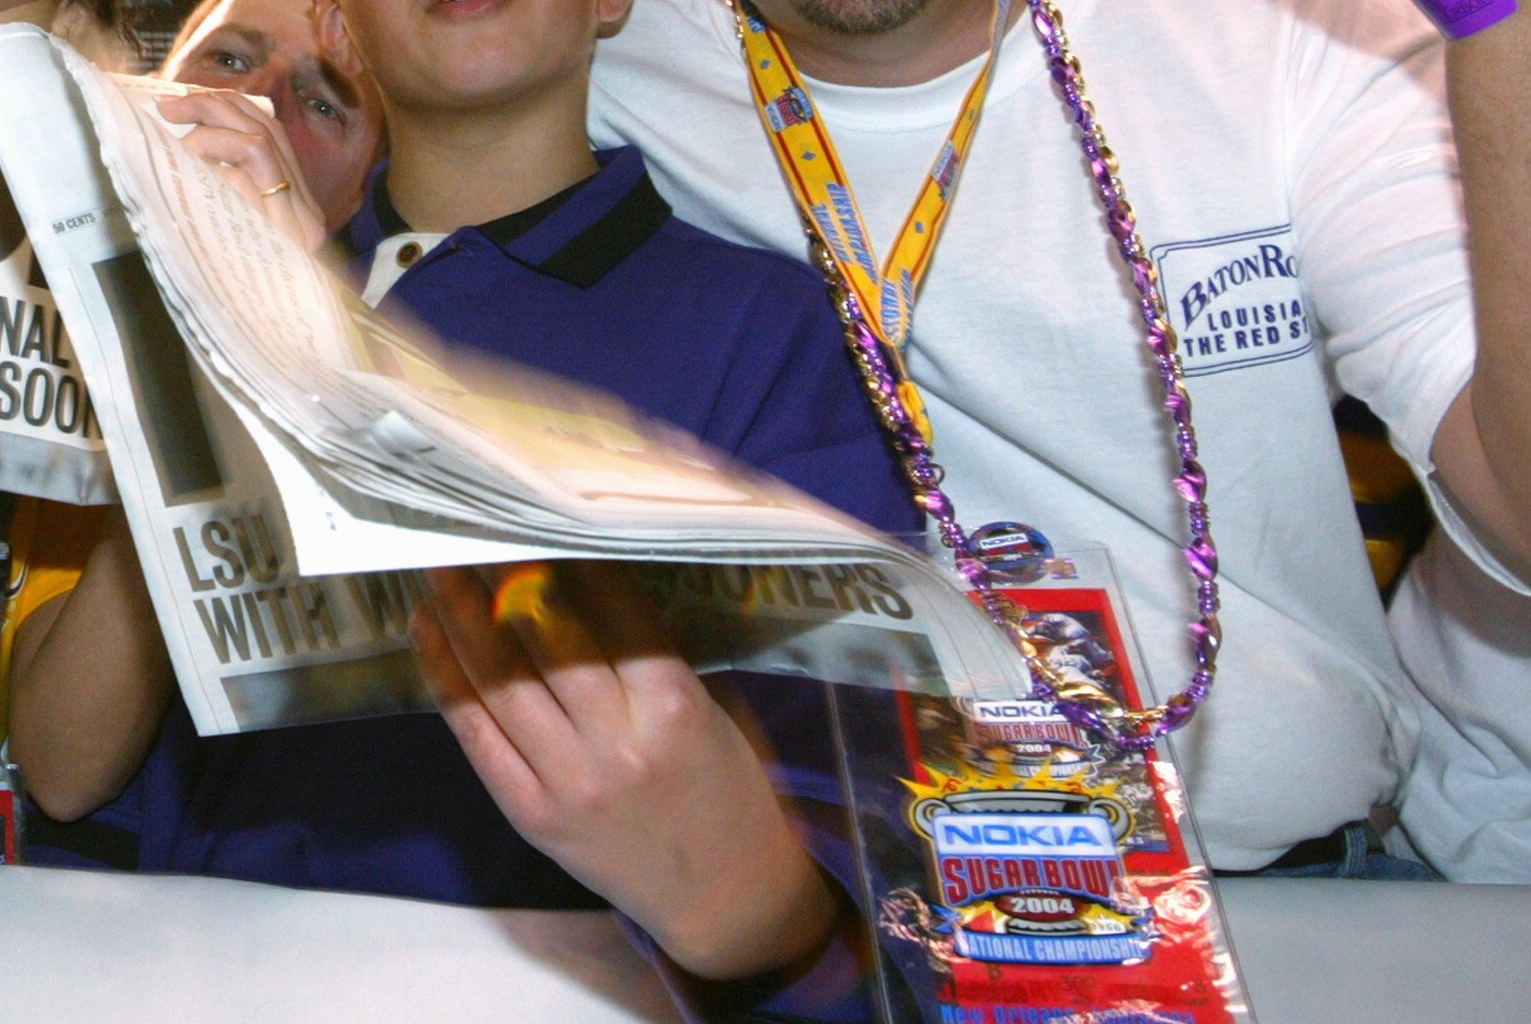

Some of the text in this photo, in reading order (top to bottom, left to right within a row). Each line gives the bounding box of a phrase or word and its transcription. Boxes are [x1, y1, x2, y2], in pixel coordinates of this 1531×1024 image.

[66, 212, 97, 230] CENTS
[1180, 255, 1261, 332] BATON
[1207, 299, 1302, 332] LOUISIA
[1184, 336, 1229, 358] THE
[1236, 326, 1281, 350] RED
[171, 512, 278, 594] LSU
[191, 576, 342, 666] WITH
[979, 705, 1065, 718] NOKIA
[1017, 743, 1053, 754] 2004
[944, 822, 1103, 848] NOKIA
[940, 856, 1051, 908] SUGAR
[1010, 895, 1076, 916] 2004
